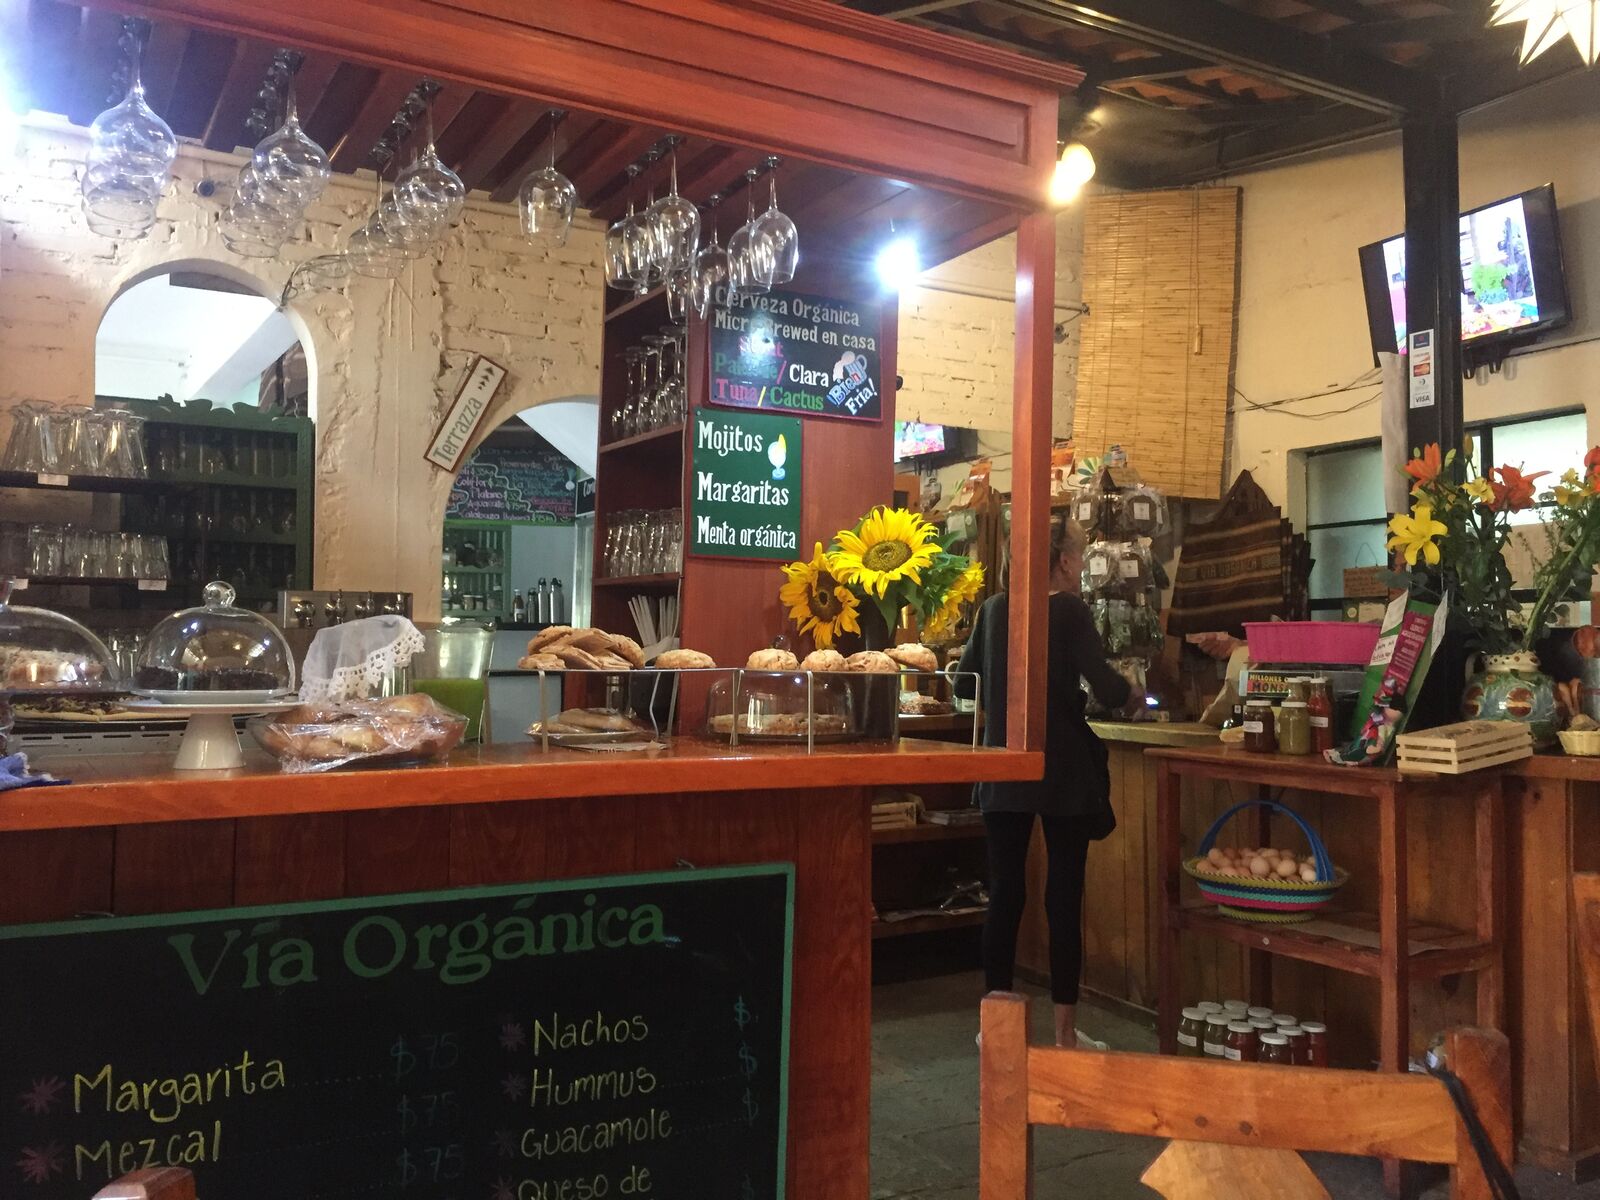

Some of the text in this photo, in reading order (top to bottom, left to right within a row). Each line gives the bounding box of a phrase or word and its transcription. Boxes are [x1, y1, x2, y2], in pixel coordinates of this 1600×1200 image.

[715, 285, 859, 327] Cerveza Orgánica
[822, 330, 838, 346] en
[842, 334, 876, 351] casa
[789, 363, 829, 387] Clara
[1416, 395, 1430, 403] VISA
[433, 397, 483, 463] Terrazza
[698, 421, 763, 457] Mojitos
[697, 472, 789, 506] Margaritas
[697, 516, 796, 550] Menta orgánica
[168, 894, 667, 995] Vía Orgánica
[533, 1011, 649, 1057] Nachos
[73, 1050, 286, 1123] Margarita
[529, 1064, 656, 1108] Hummus
[75, 1120, 222, 1181] Mezcal
[520, 1108, 672, 1161] Guacamole
[518, 1170, 608, 1200] Queso
[620, 1165, 652, 1193] de
